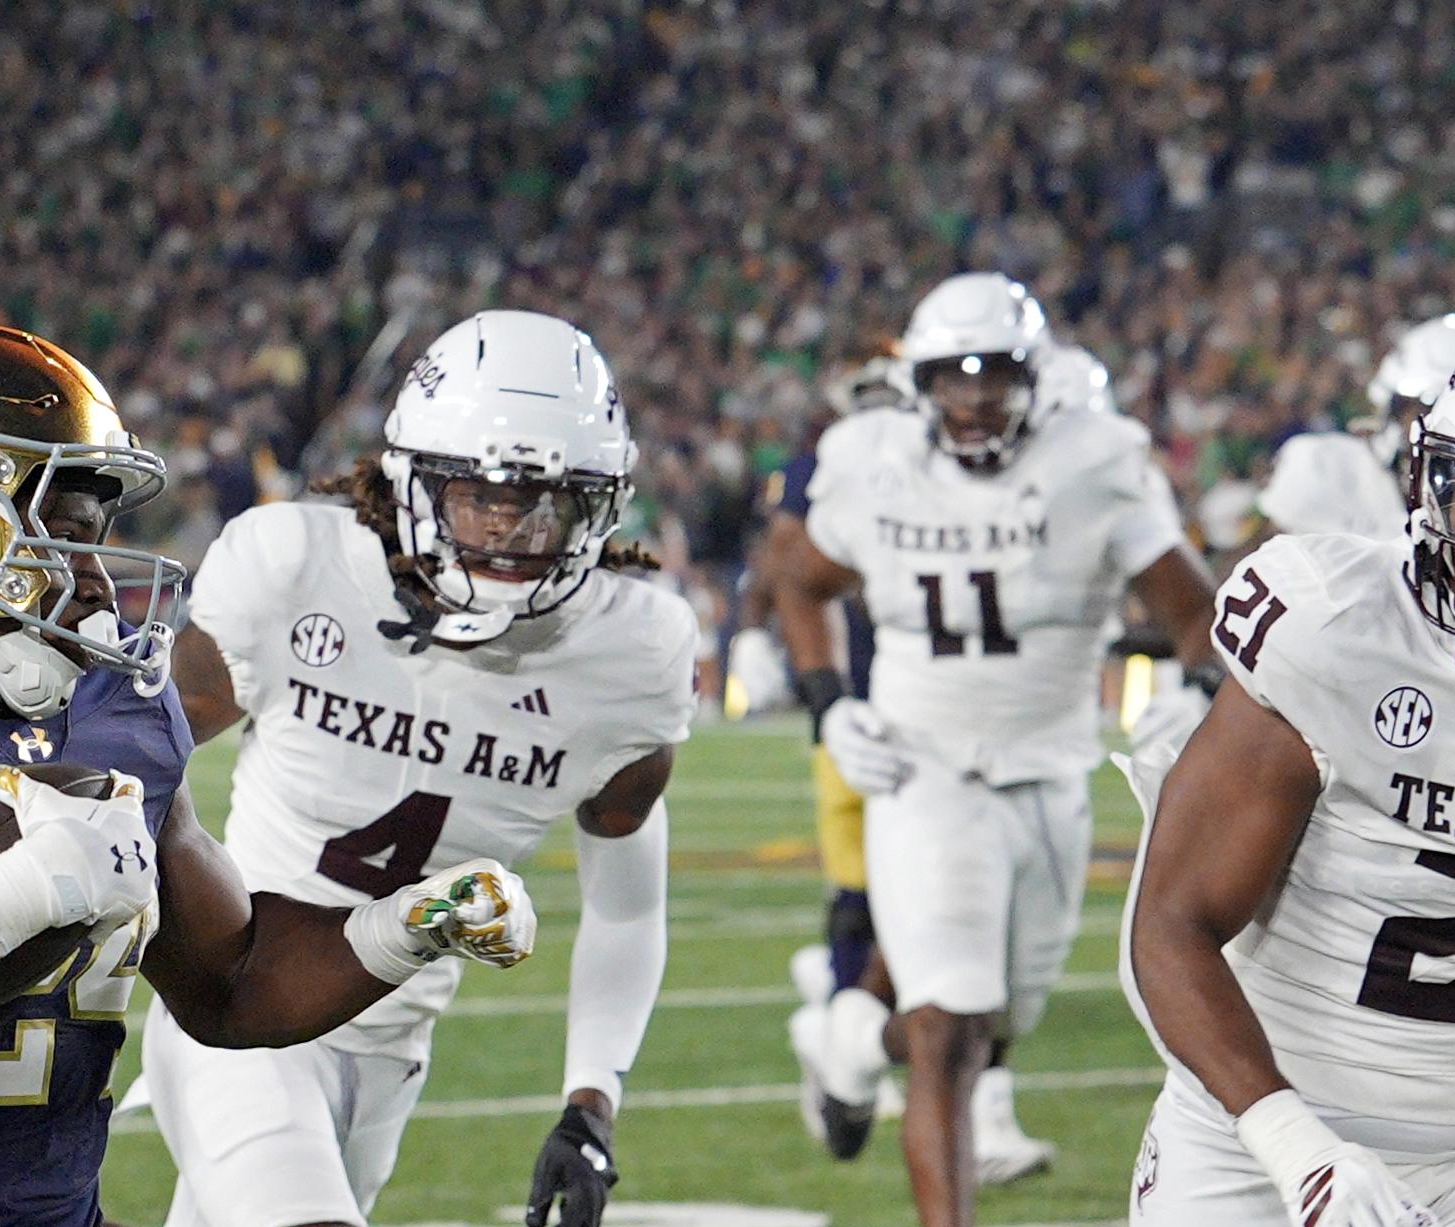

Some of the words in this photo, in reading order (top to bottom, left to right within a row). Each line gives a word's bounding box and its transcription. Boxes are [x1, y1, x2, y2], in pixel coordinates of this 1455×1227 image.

[291, 613, 345, 667] SEC
[916, 571, 1019, 656] 11
[1215, 567, 1288, 672] 21
[289, 677, 450, 765] TEXAS
[463, 733, 567, 789] A&M
[1374, 686, 1434, 748] SEC
[315, 790, 452, 898] 4
